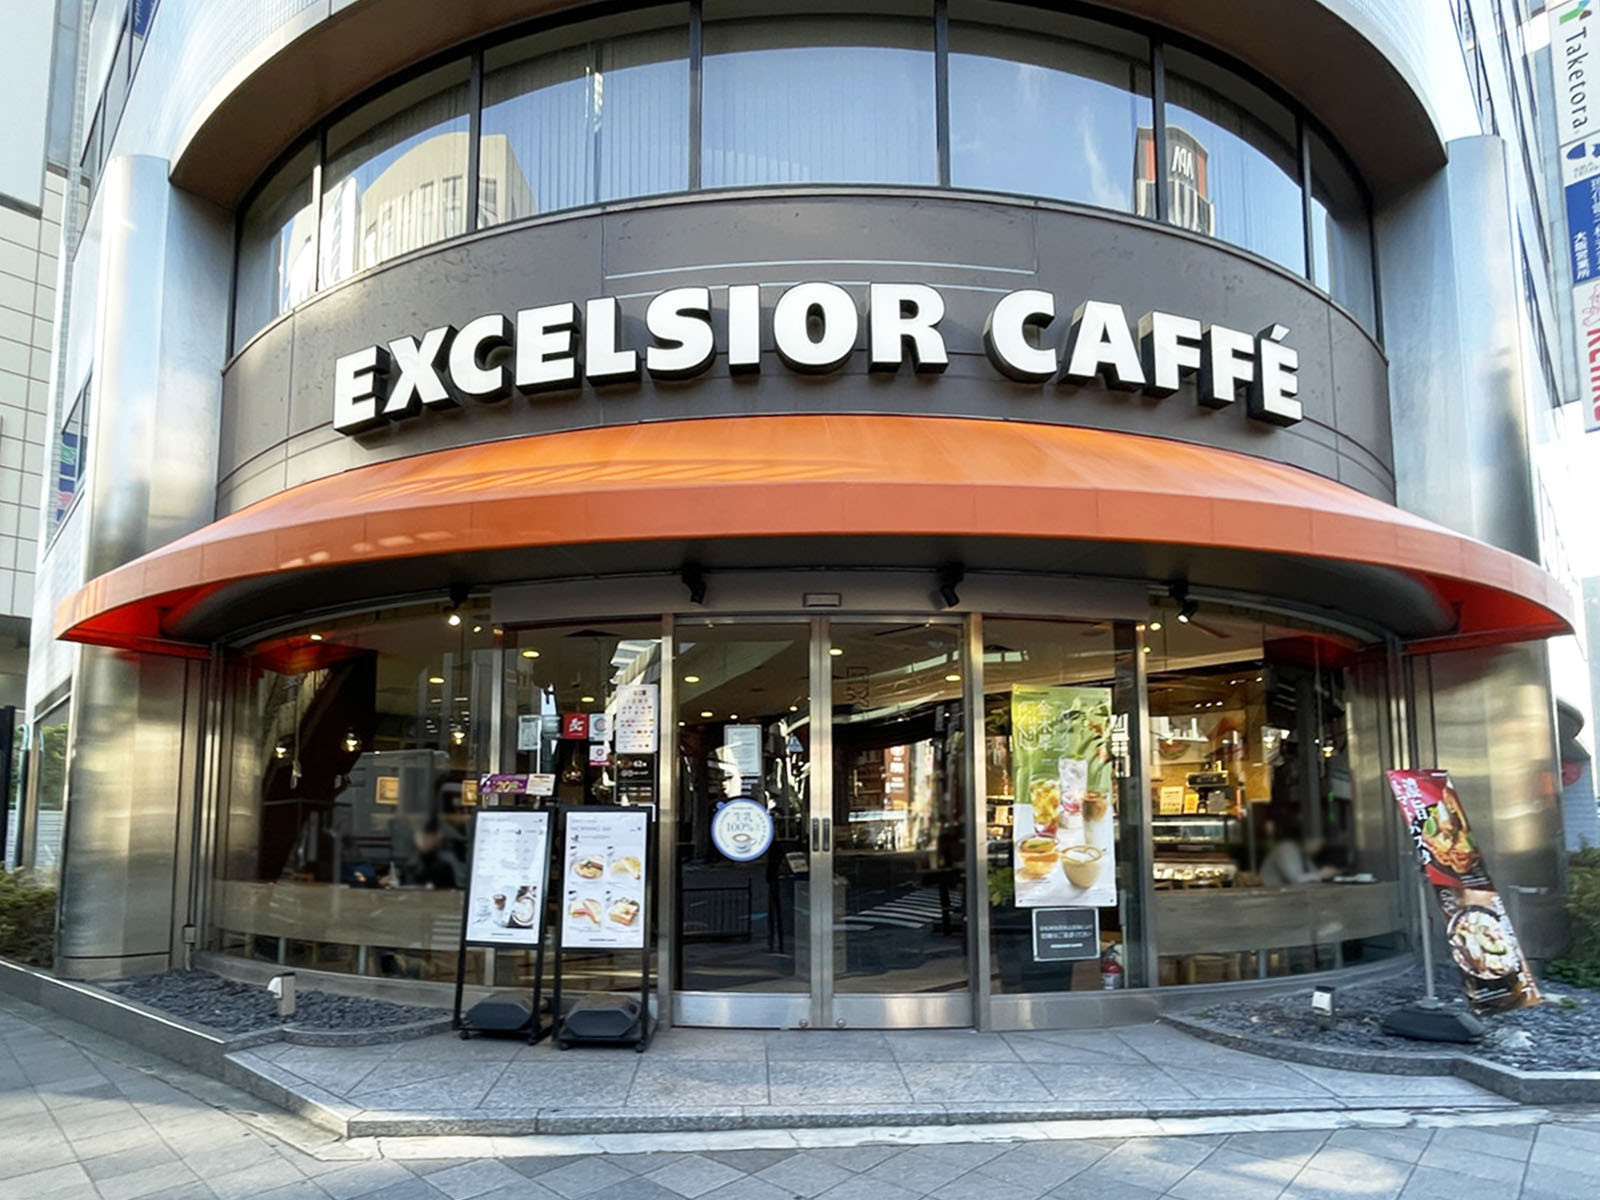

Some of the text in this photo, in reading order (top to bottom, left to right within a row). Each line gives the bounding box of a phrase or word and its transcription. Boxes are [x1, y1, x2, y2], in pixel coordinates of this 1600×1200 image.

[1565, 26, 1589, 129] Taketora
[333, 281, 1304, 432] EXCELSIOR CAFFÉ
